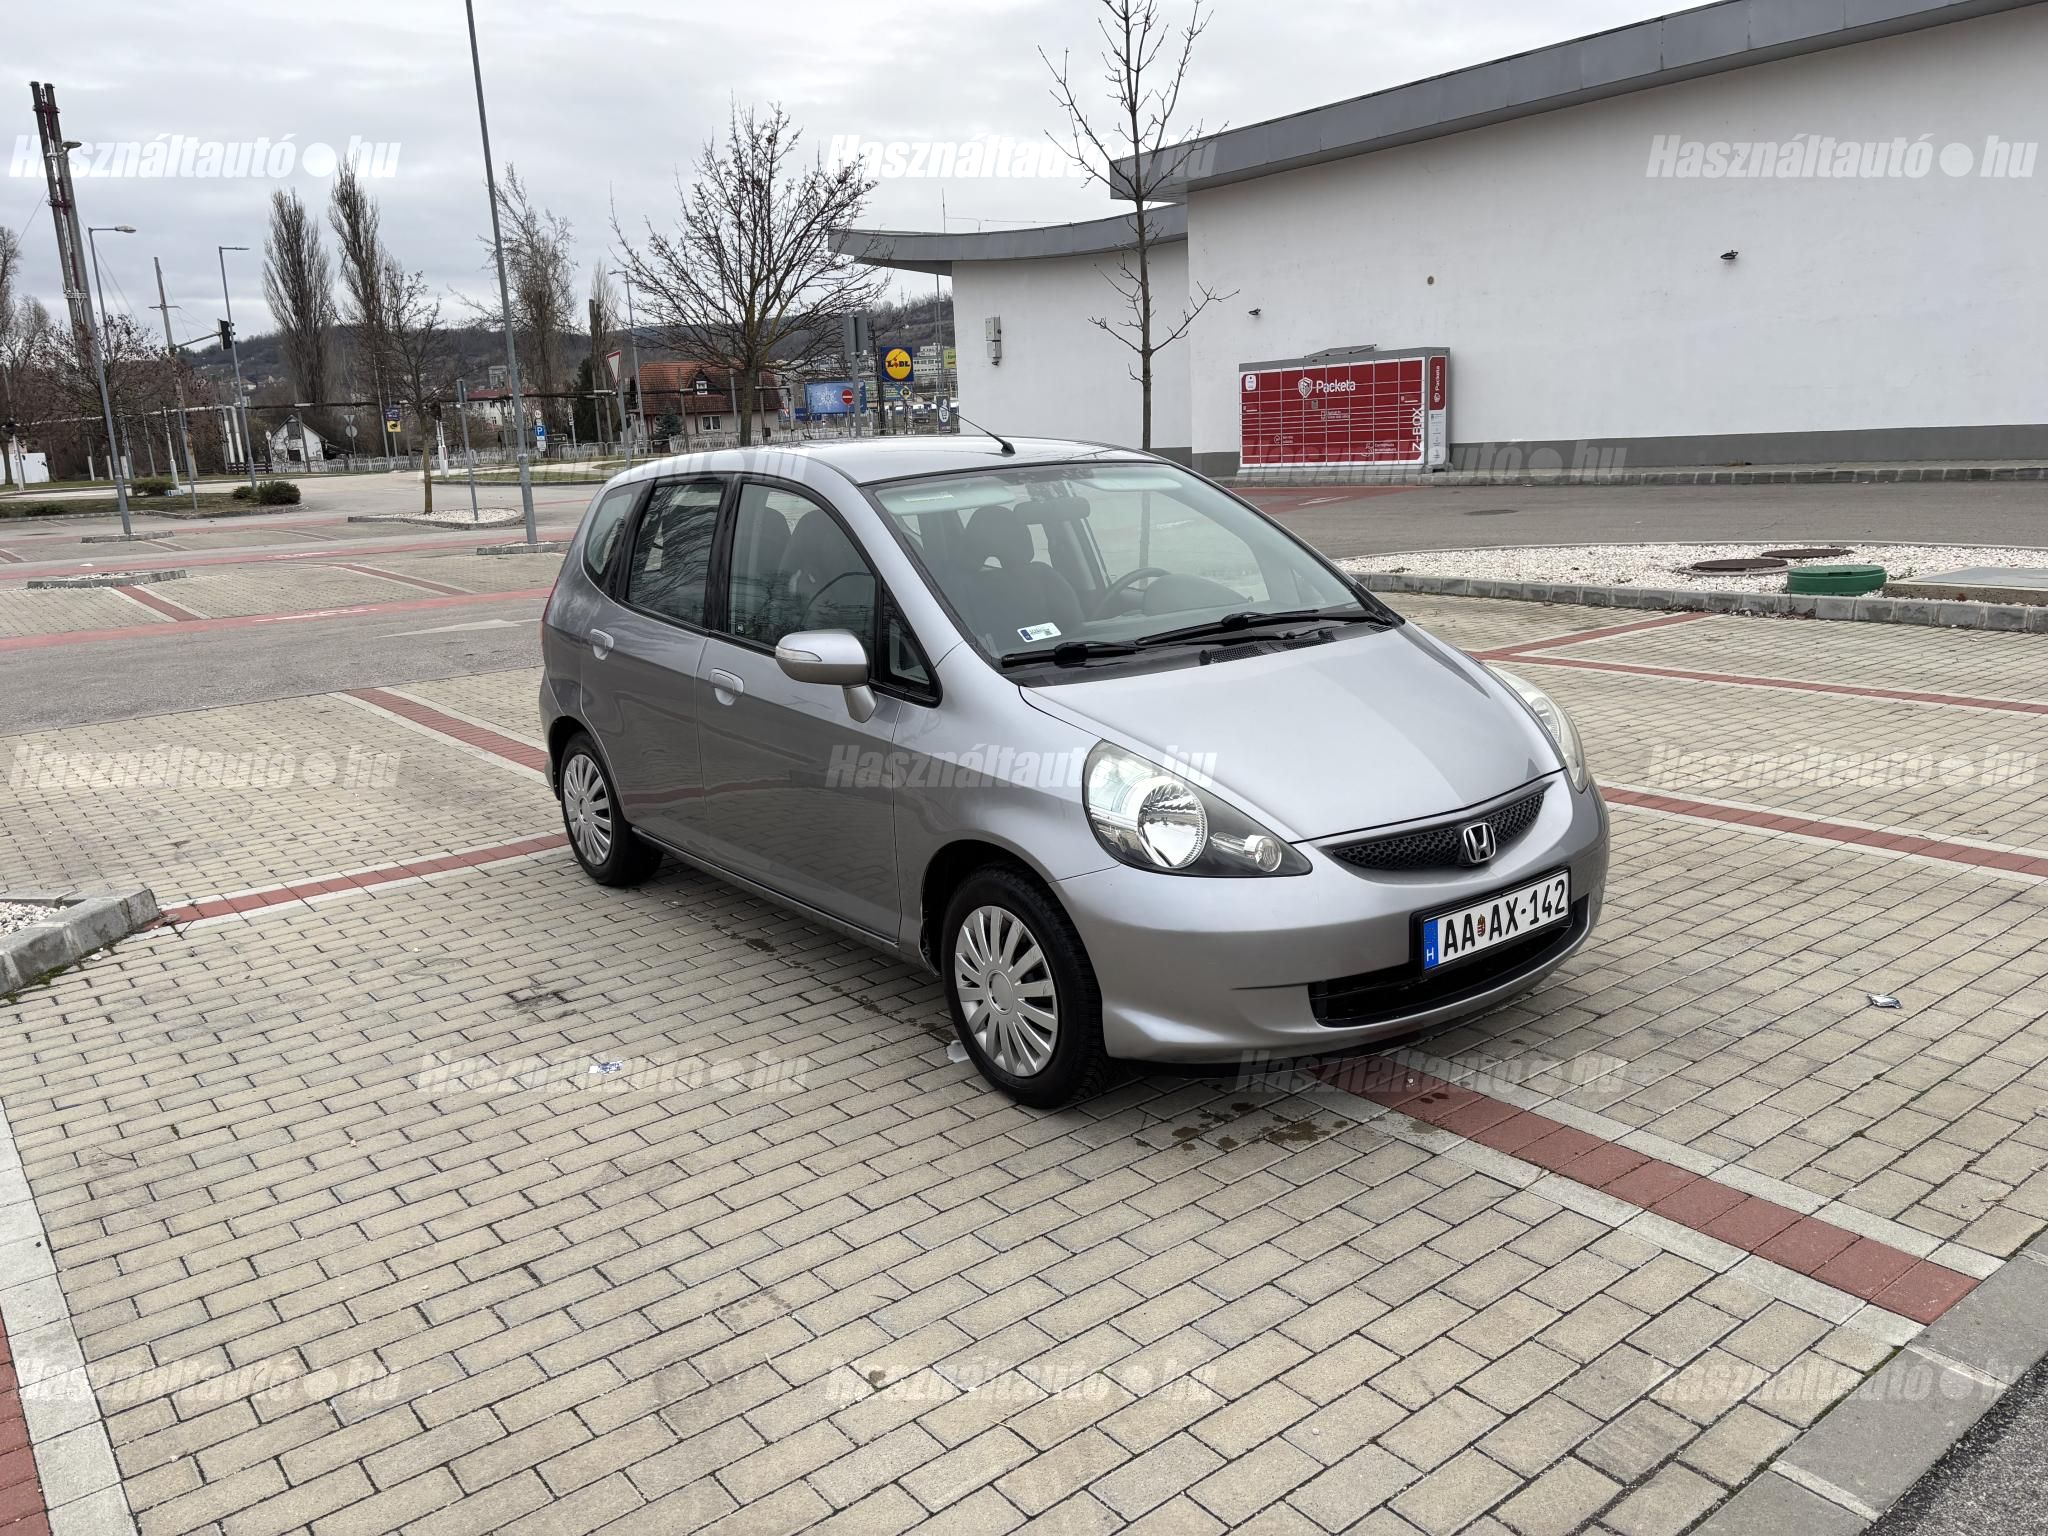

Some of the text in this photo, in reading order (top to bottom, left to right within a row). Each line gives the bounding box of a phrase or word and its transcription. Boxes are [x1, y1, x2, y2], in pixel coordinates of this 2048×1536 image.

[1316, 379, 1356, 393] Packeta
[1443, 878, 1567, 957] AA AX-142
[1426, 947, 1435, 962] H
